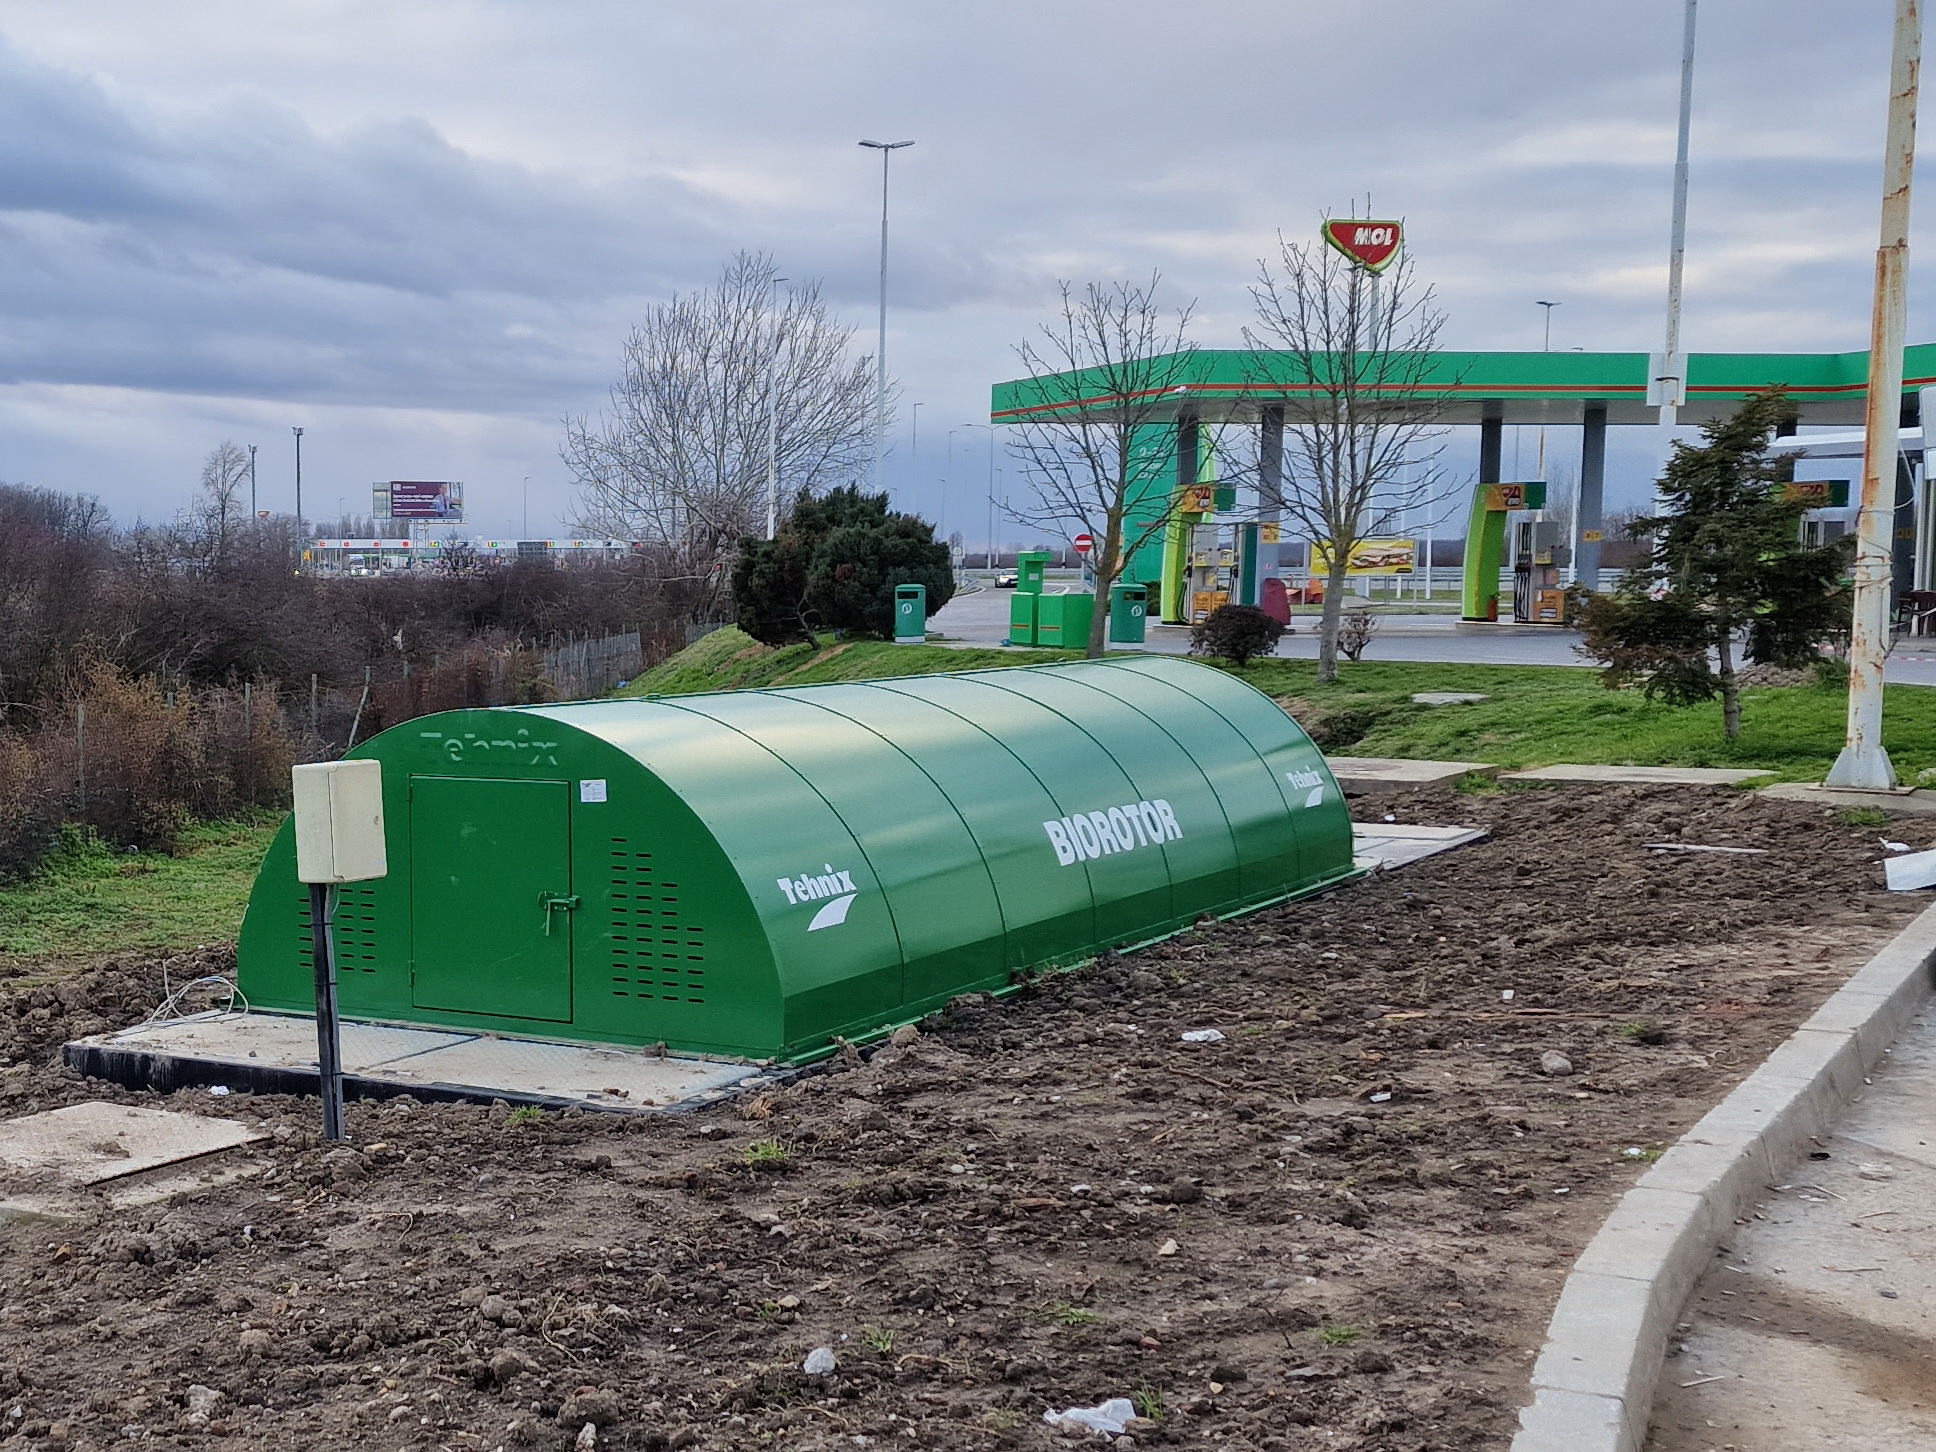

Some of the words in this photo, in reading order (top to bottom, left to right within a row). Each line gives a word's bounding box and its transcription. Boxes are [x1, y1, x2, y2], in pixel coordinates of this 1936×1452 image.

[1354, 227, 1394, 246] MOL
[1286, 764, 1325, 790] Tehnix
[1043, 799, 1184, 867] BIOROTOR
[776, 863, 857, 905] Tehnix
